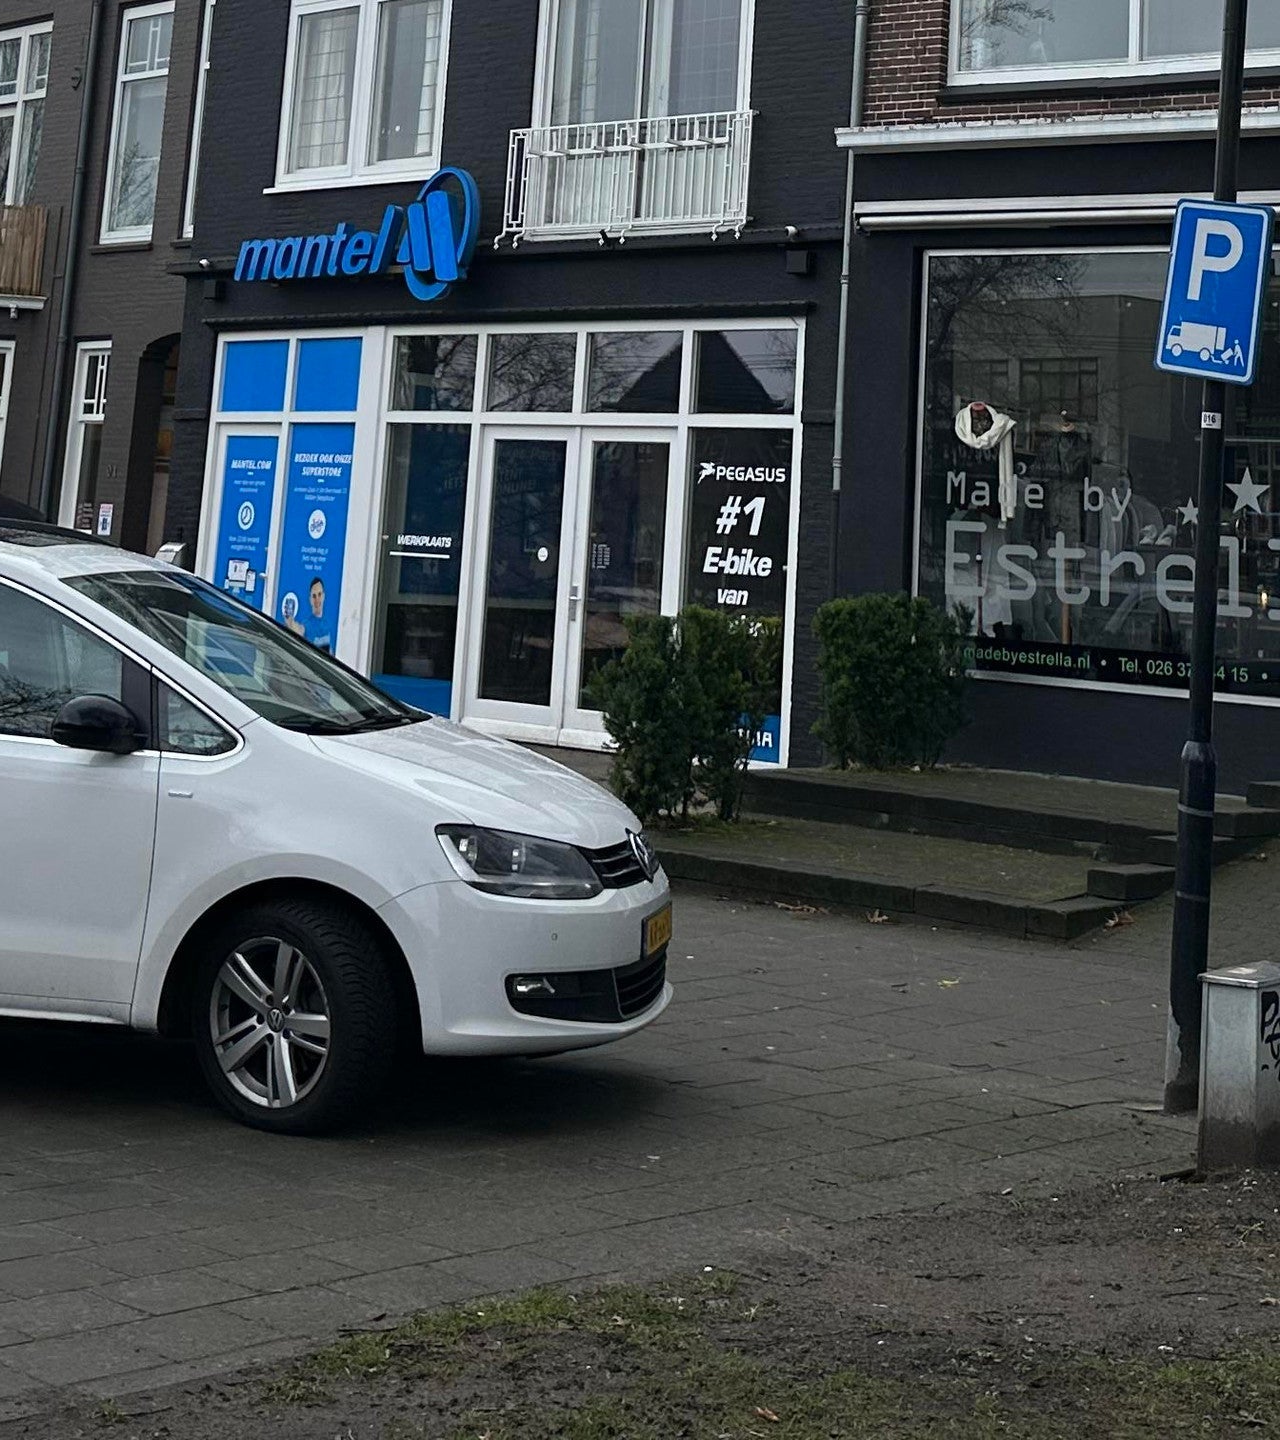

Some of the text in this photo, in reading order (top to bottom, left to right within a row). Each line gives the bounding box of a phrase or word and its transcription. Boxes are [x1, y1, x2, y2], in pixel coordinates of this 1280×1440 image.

[233, 204, 404, 282] mantel
[1186, 218, 1244, 301] P
[230, 459, 273, 470] MANTEL.COM
[301, 466, 343, 477] SUPERSTORE
[715, 465, 786, 483] PEGASUS
[1083, 476, 1133, 522] by
[715, 494, 766, 537] #1
[397, 534, 452, 548] WERKPLAATS
[702, 546, 773, 578] E-bike
[717, 587, 749, 606] van
[1118, 656, 1143, 673] Tel.
[1146, 659, 1174, 676] 026
[1230, 668, 1249, 683] 15
